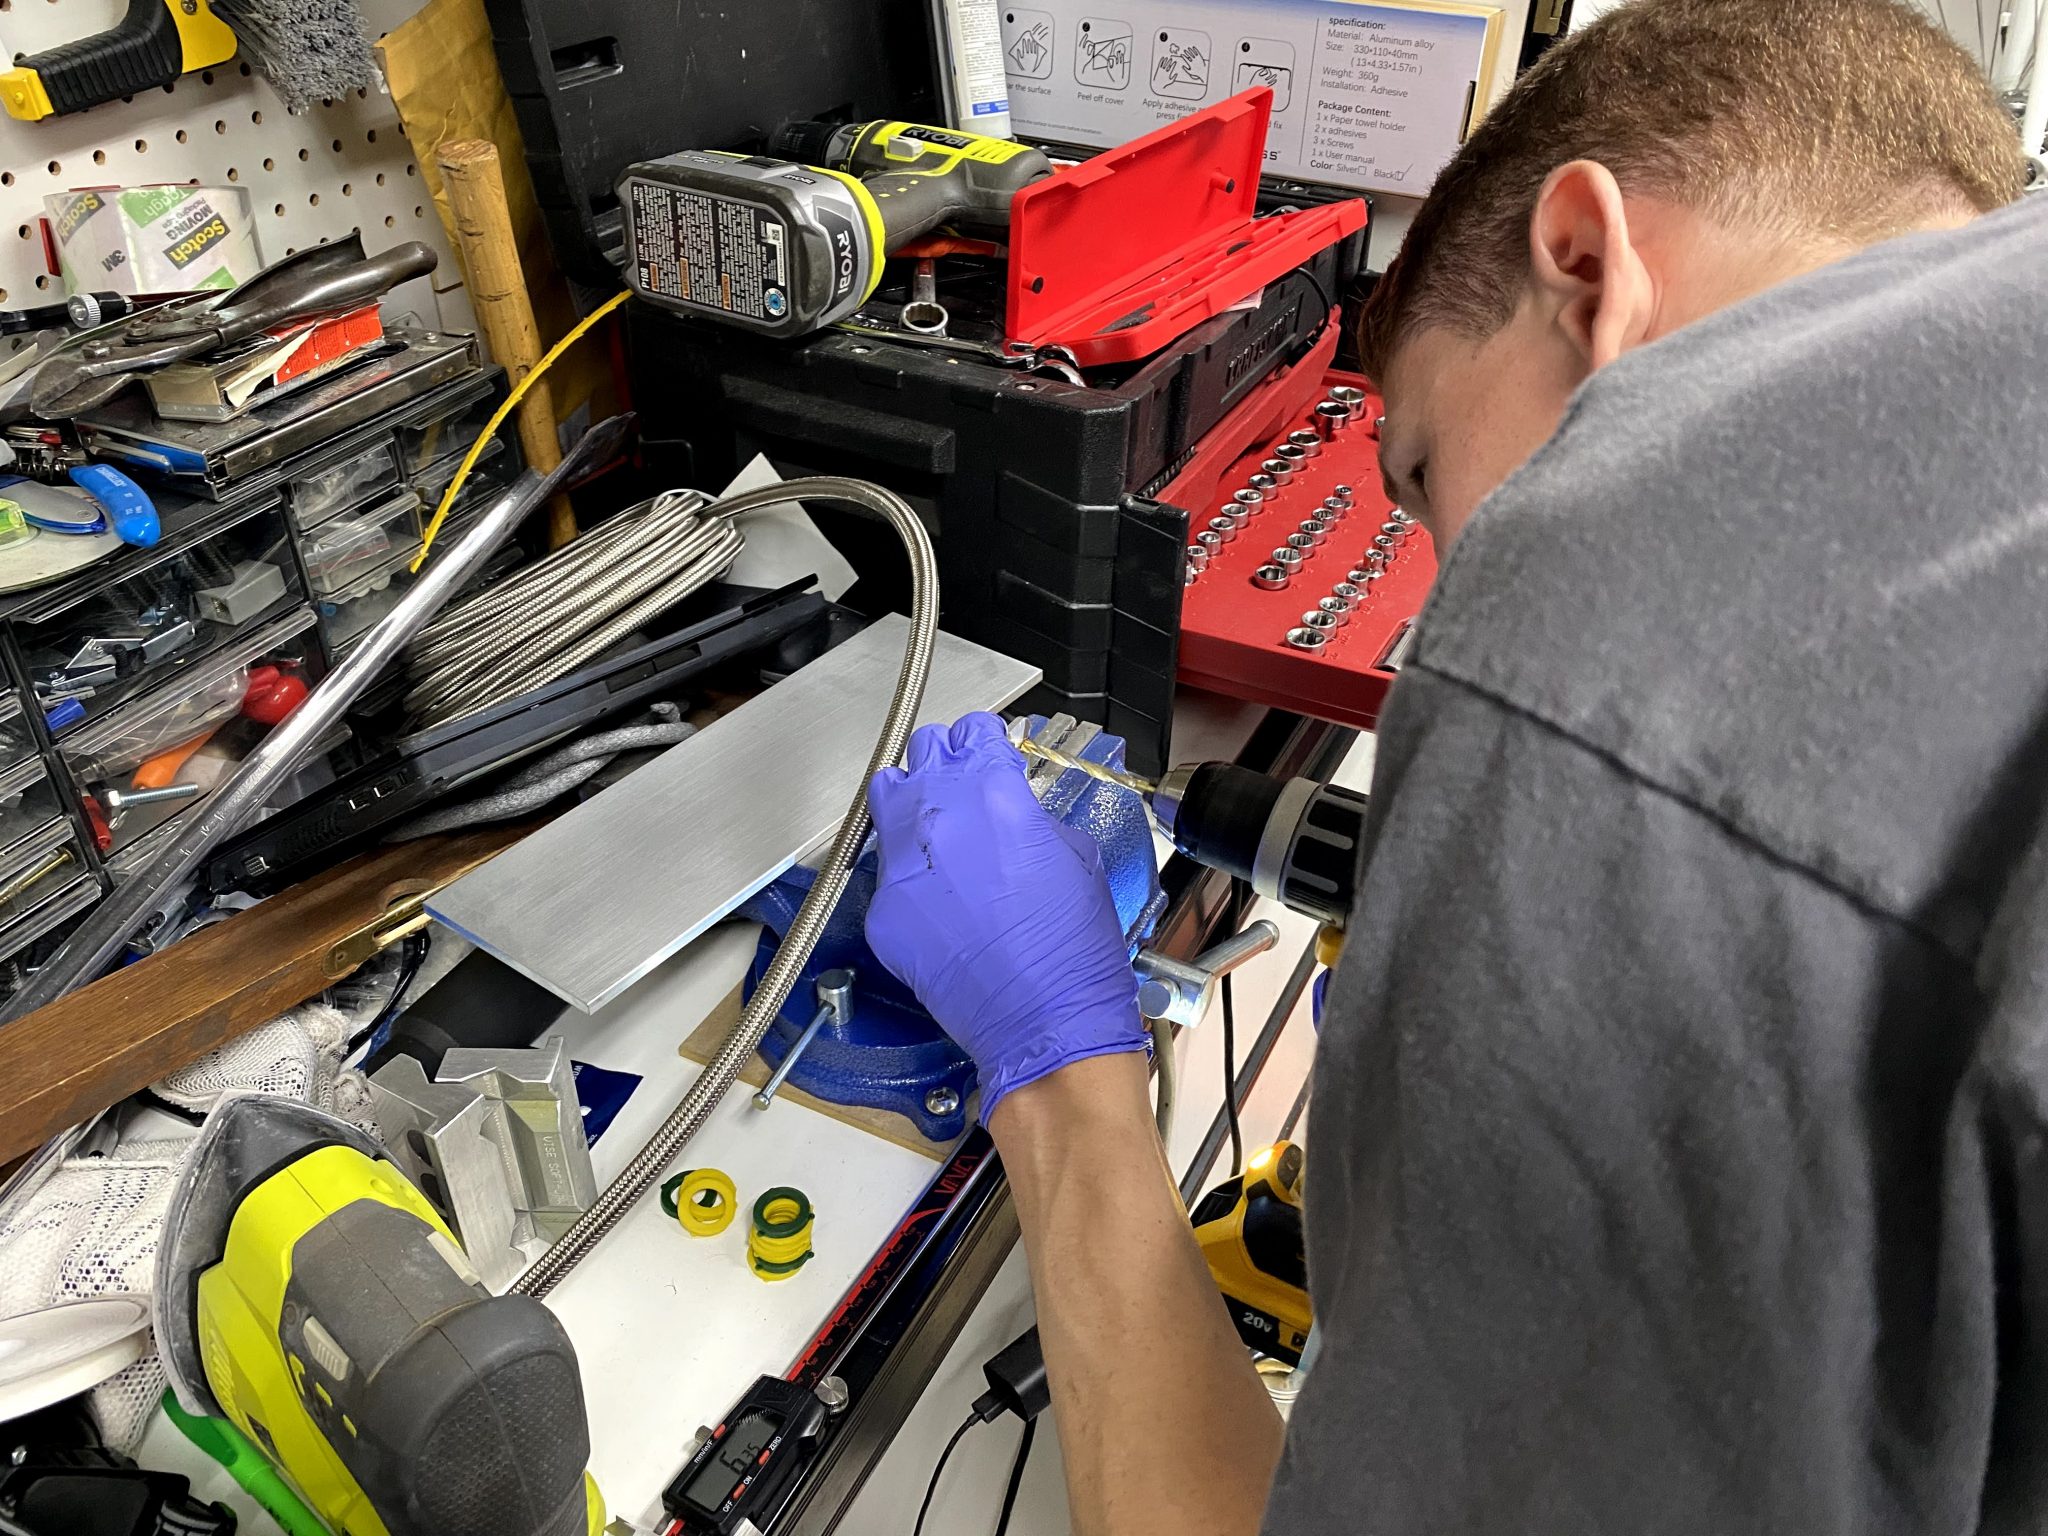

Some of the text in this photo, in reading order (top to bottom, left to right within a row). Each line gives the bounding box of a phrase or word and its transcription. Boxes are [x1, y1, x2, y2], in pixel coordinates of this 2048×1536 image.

[1328, 17, 1386, 30] specification:
[1326, 40, 1344, 52] Size:
[1328, 28, 1435, 51] Material: Aluminum alloy
[1322, 66, 1379, 82] Weight: 360g
[1015, 83, 1026, 92] the
[1027, 85, 1052, 96] surface
[1370, 85, 1408, 98] Adhesive
[1077, 92, 1124, 106] Peel off cover
[1142, 98, 1162, 110] Apply
[1164, 102, 1196, 113] adhesive
[1318, 100, 1392, 118] Package Content:
[1156, 112, 1176, 122] press
[1330, 114, 1353, 125] Paper
[1355, 118, 1378, 128] towel
[1380, 121, 1406, 132] holder
[906, 127, 970, 147] RYOBI
[1328, 127, 1368, 139] adhesives
[1326, 138, 1354, 150] Screws
[1325, 150, 1343, 160] User
[1345, 154, 1376, 164] manual
[1336, 164, 1358, 174] Silver
[1374, 168, 1395, 179] Black
[60, 193, 99, 238] Scotch
[166, 203, 214, 241] MOVING
[169, 219, 226, 263] Scotch
[101, 250, 126, 272] 3M
[836, 230, 852, 294] RYOBI
[640, 268, 650, 289] P108
[768, 1436, 782, 1451] ZERO
[743, 1475, 752, 1485] ON
[722, 1501, 734, 1513] OFF
